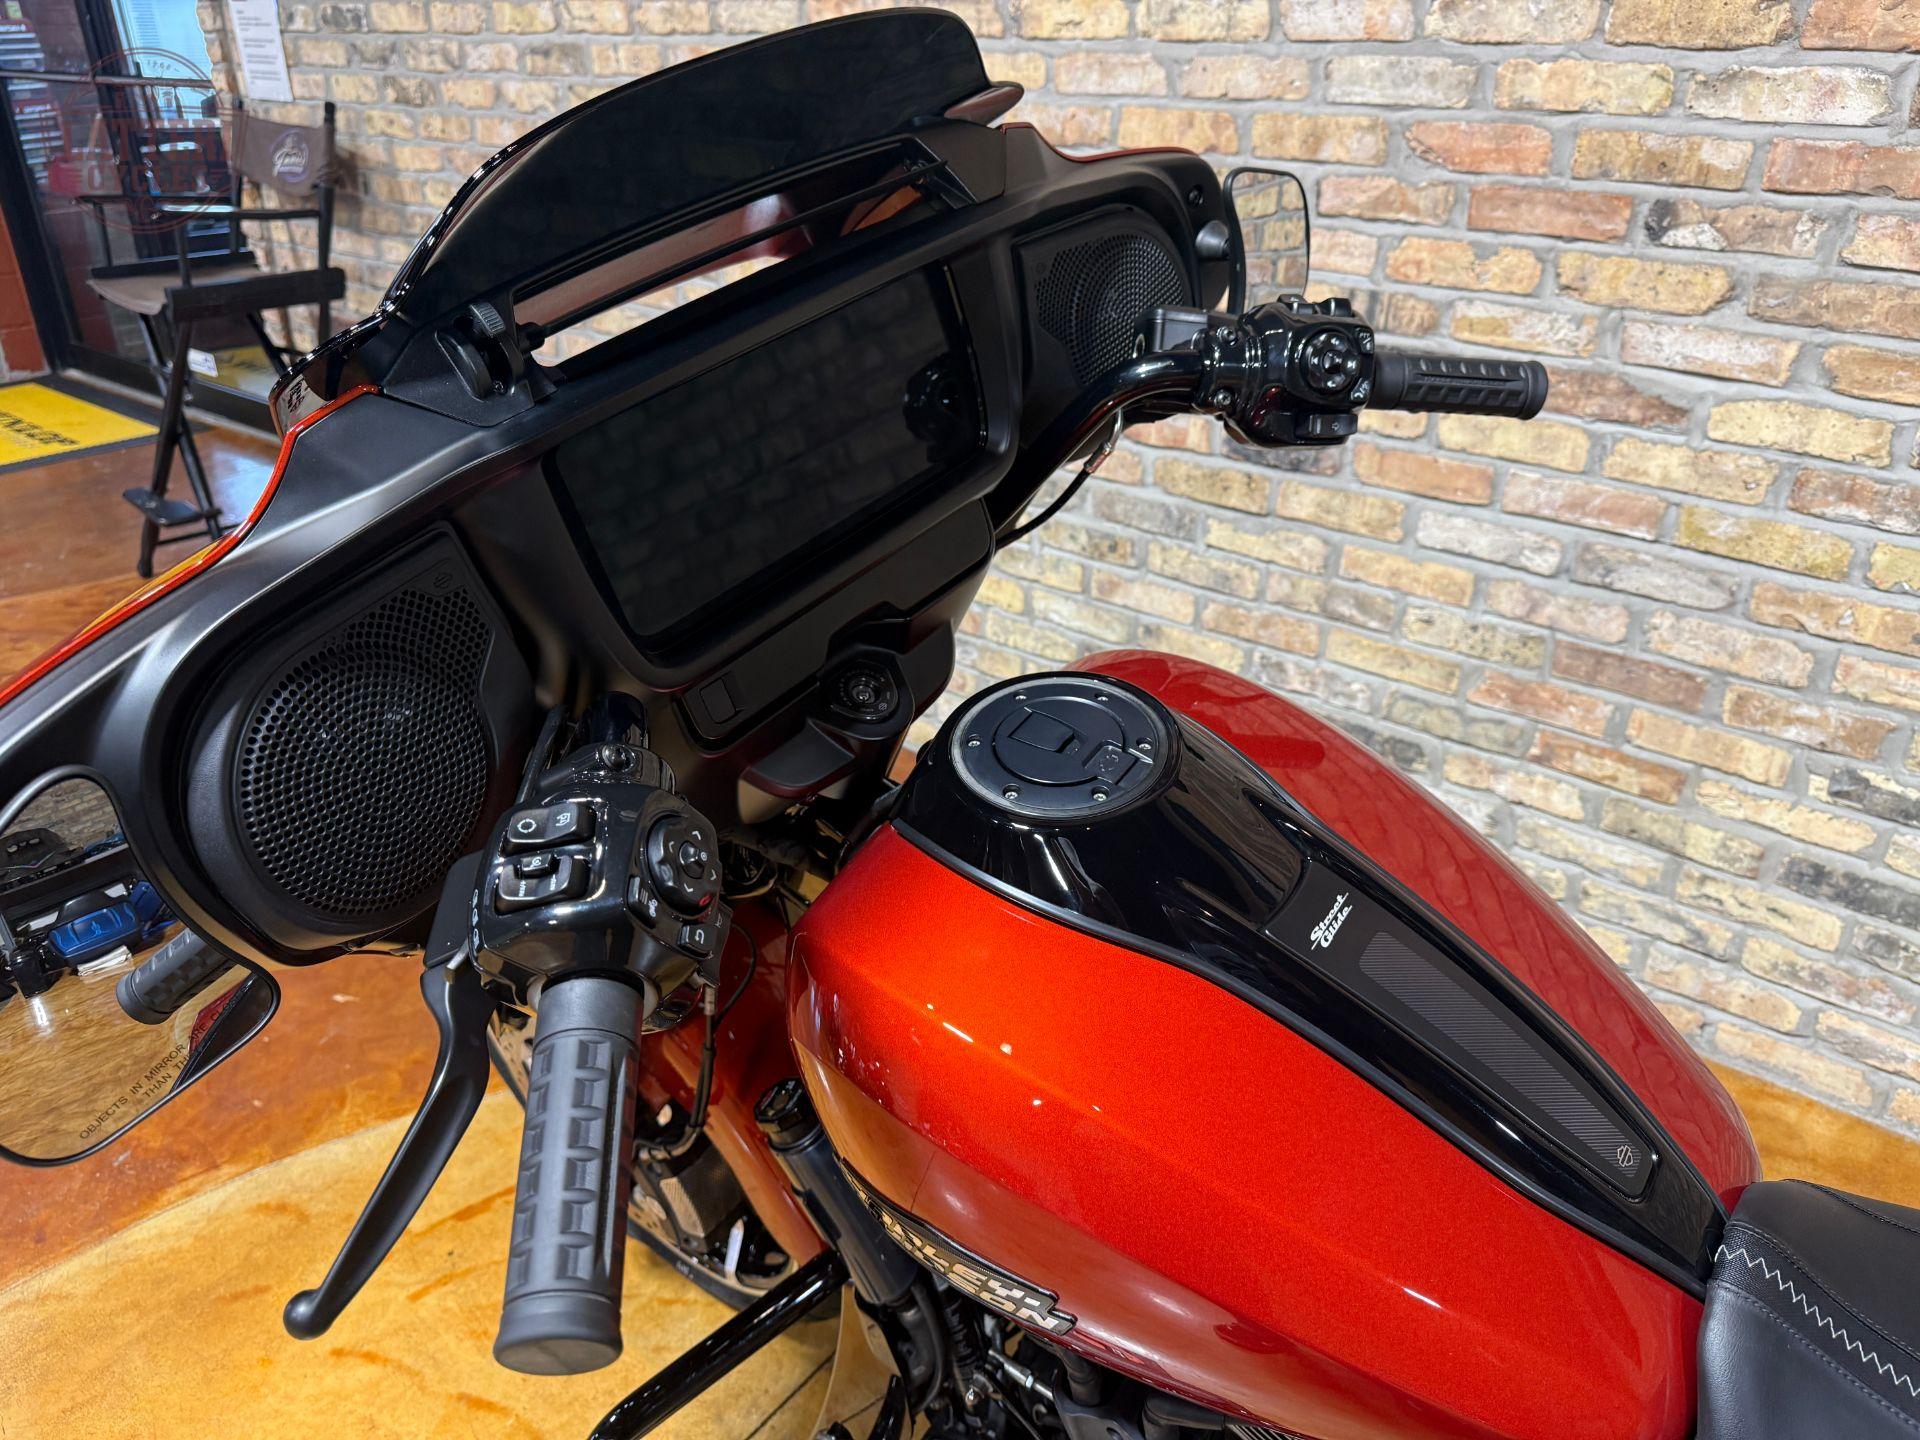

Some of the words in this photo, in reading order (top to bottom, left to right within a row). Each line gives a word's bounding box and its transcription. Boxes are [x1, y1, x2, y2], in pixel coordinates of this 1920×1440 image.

[1310, 892, 1349, 950] Street
[1320, 905, 1353, 948] Glide
[79, 1096, 128, 1139] OBJECTS
[129, 1081, 144, 1095] IN
[144, 1043, 186, 1082] MIRROR
[188, 1022, 208, 1041] ARE
[142, 1072, 172, 1098] THAN
